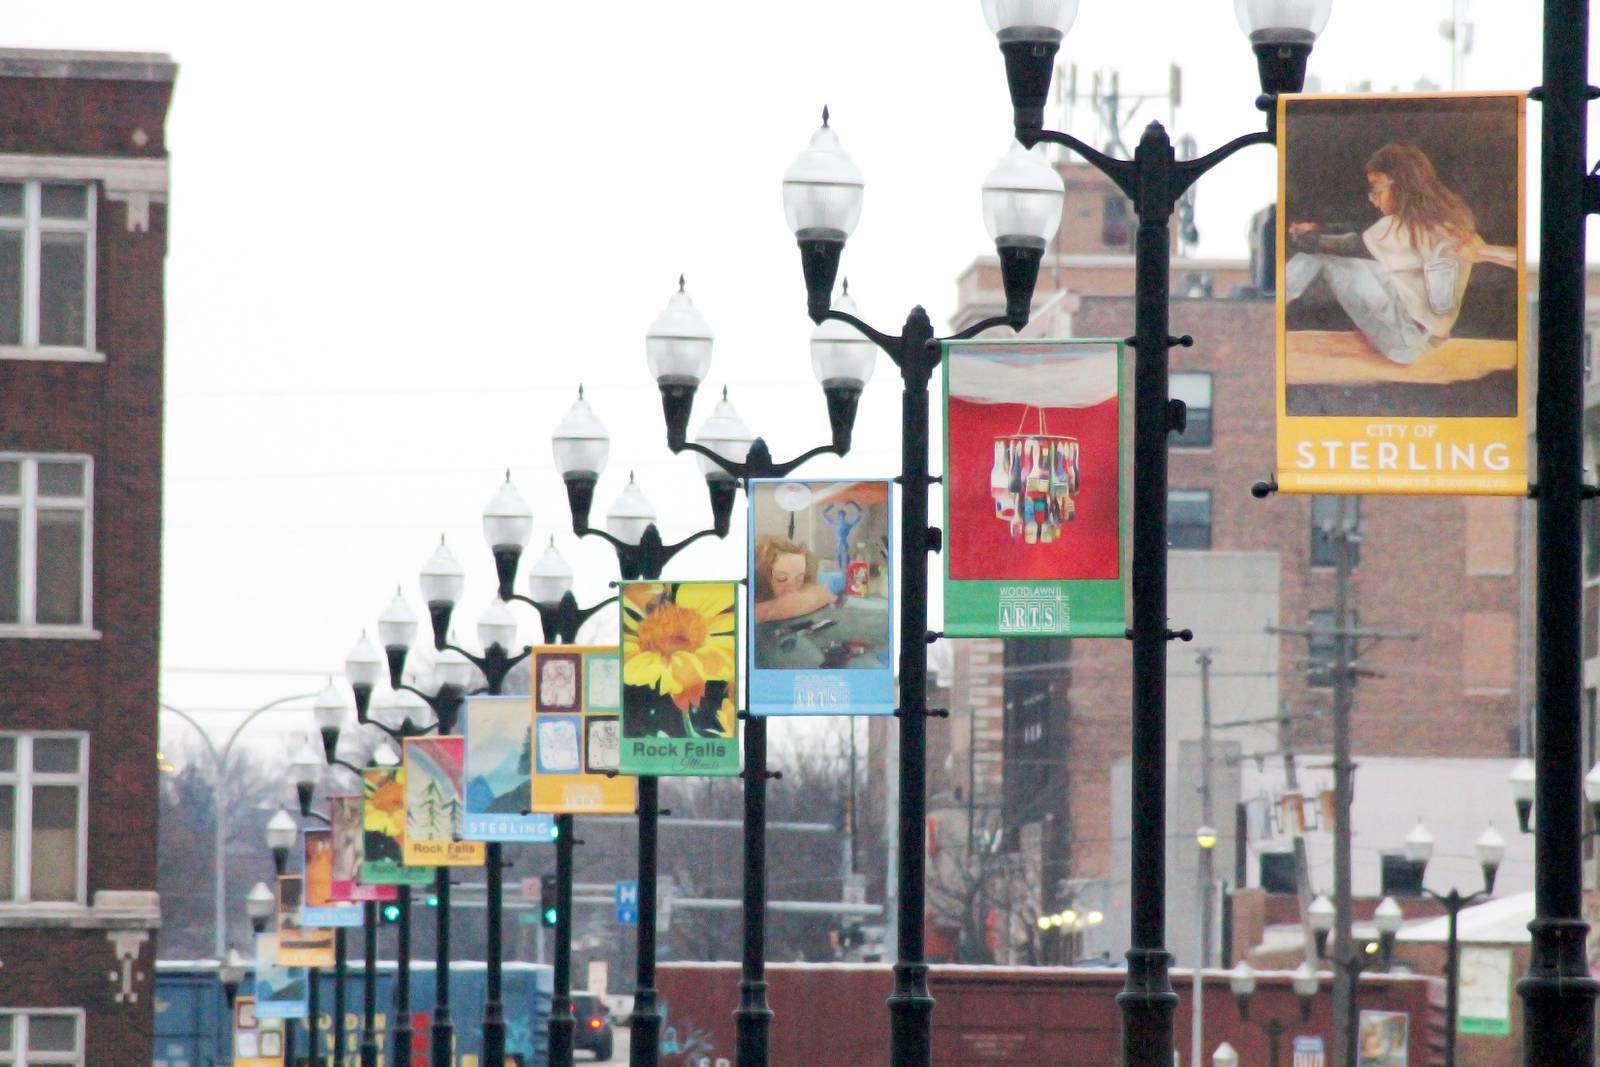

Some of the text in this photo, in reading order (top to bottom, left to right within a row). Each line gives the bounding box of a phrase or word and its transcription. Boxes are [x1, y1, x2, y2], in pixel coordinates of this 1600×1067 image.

[1366, 423, 1438, 438] CITY OF
[1295, 440, 1511, 471] STERLING
[1000, 586, 1056, 597] WOODLAWN
[1000, 606, 1054, 628] ARTS
[633, 741, 727, 757] Rock Falls
[470, 822, 546, 834] STERLING
[413, 843, 476, 854] Rock Falls
